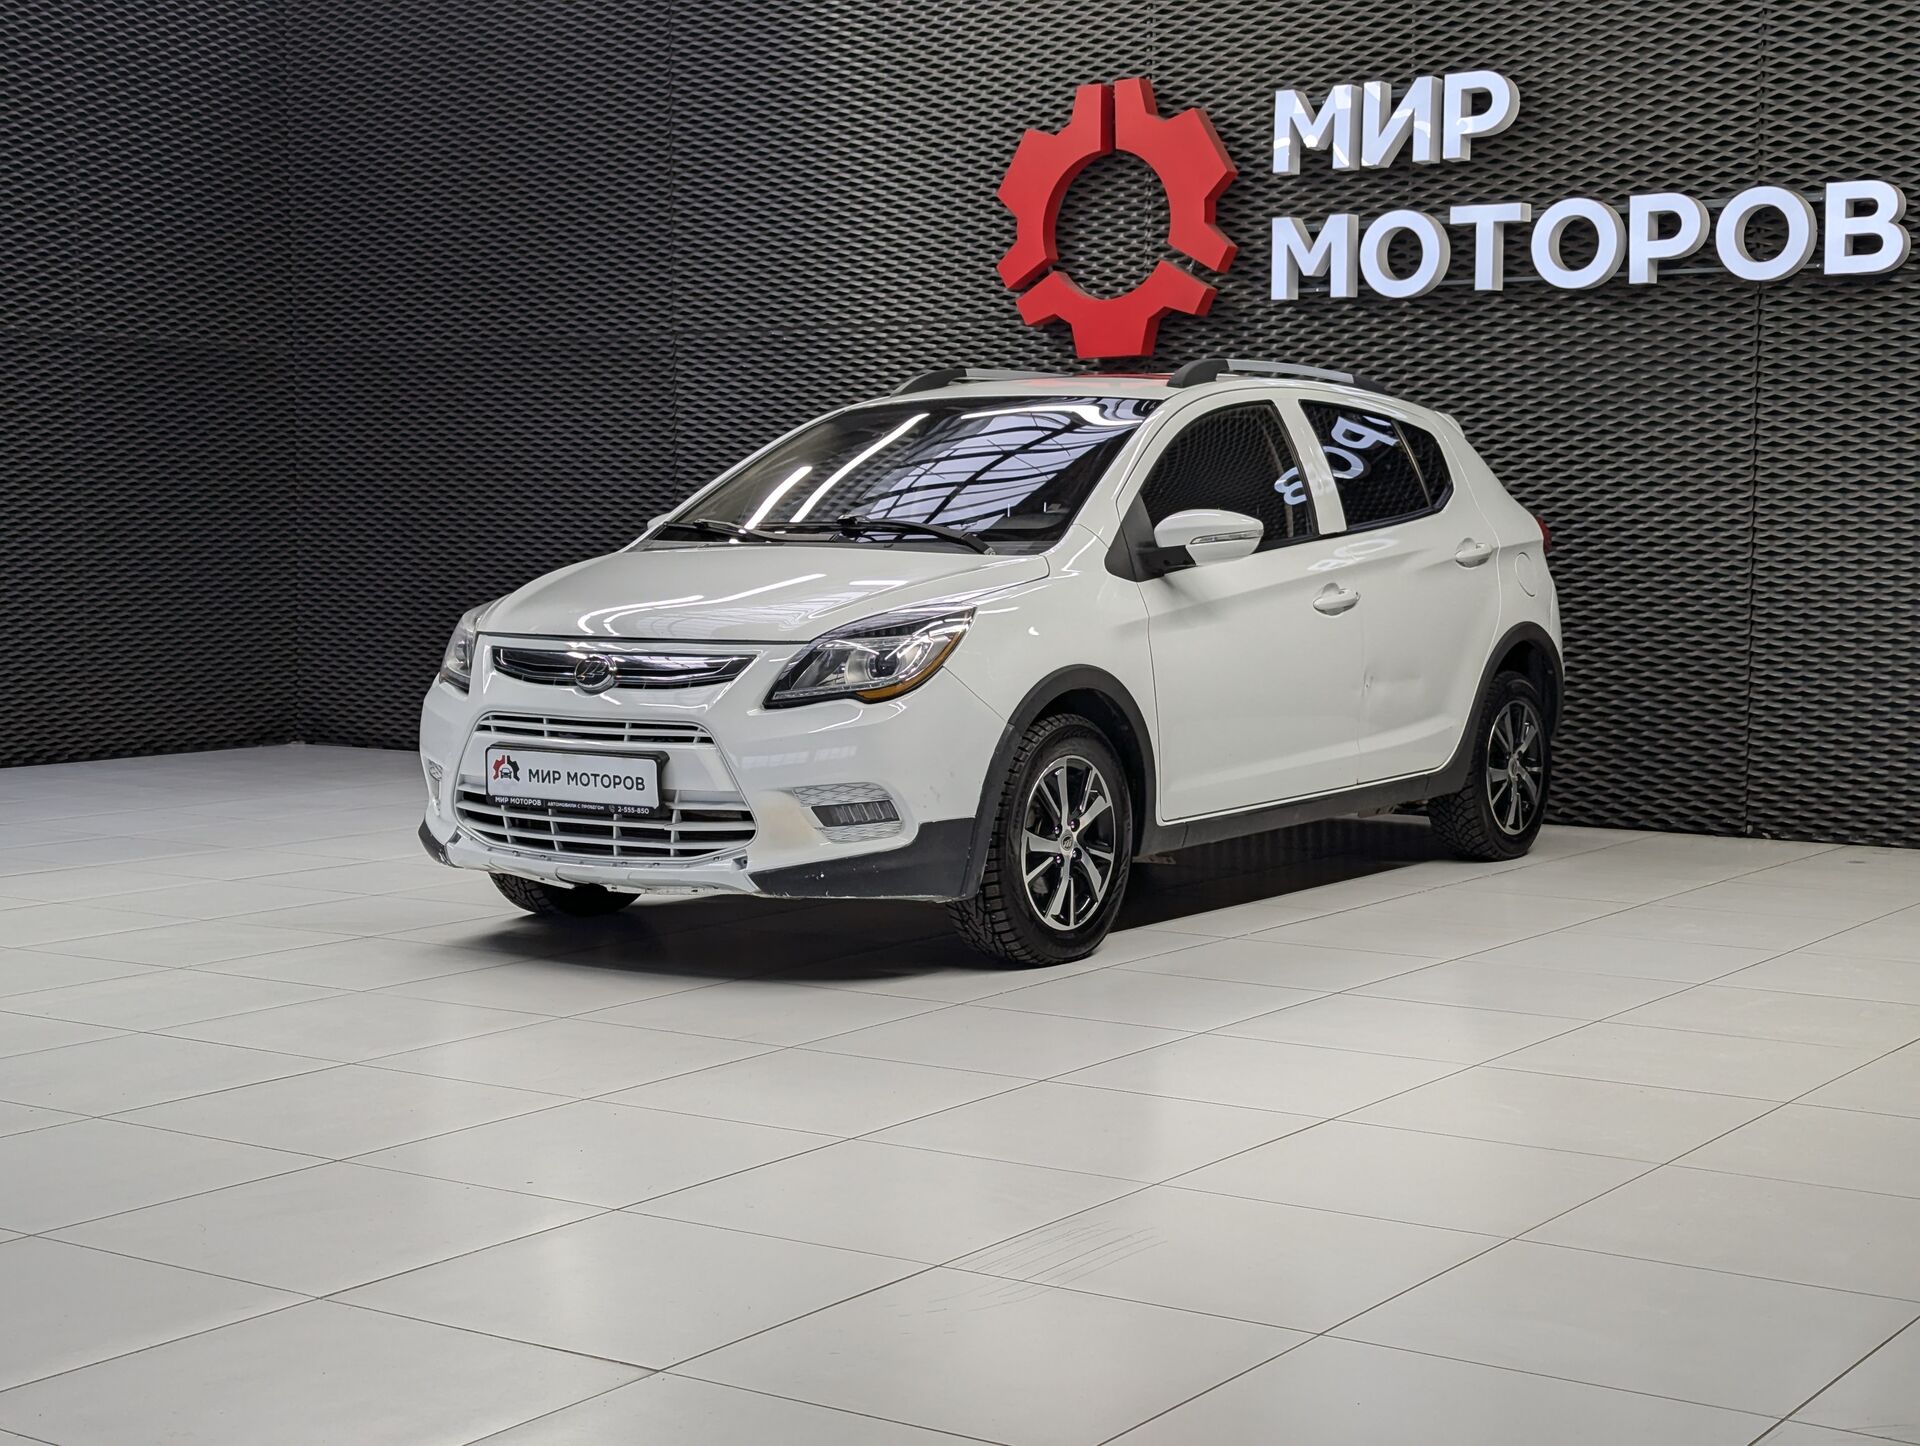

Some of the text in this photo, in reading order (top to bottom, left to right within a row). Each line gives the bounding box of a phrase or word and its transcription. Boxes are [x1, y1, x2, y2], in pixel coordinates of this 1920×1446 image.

[1273, 70, 1520, 174] МИР
[1271, 180, 1911, 300] МОТОРОВ
[510, 797, 541, 806] МОТОРОВ
[528, 768, 645, 791] МИР МОТОРОВ
